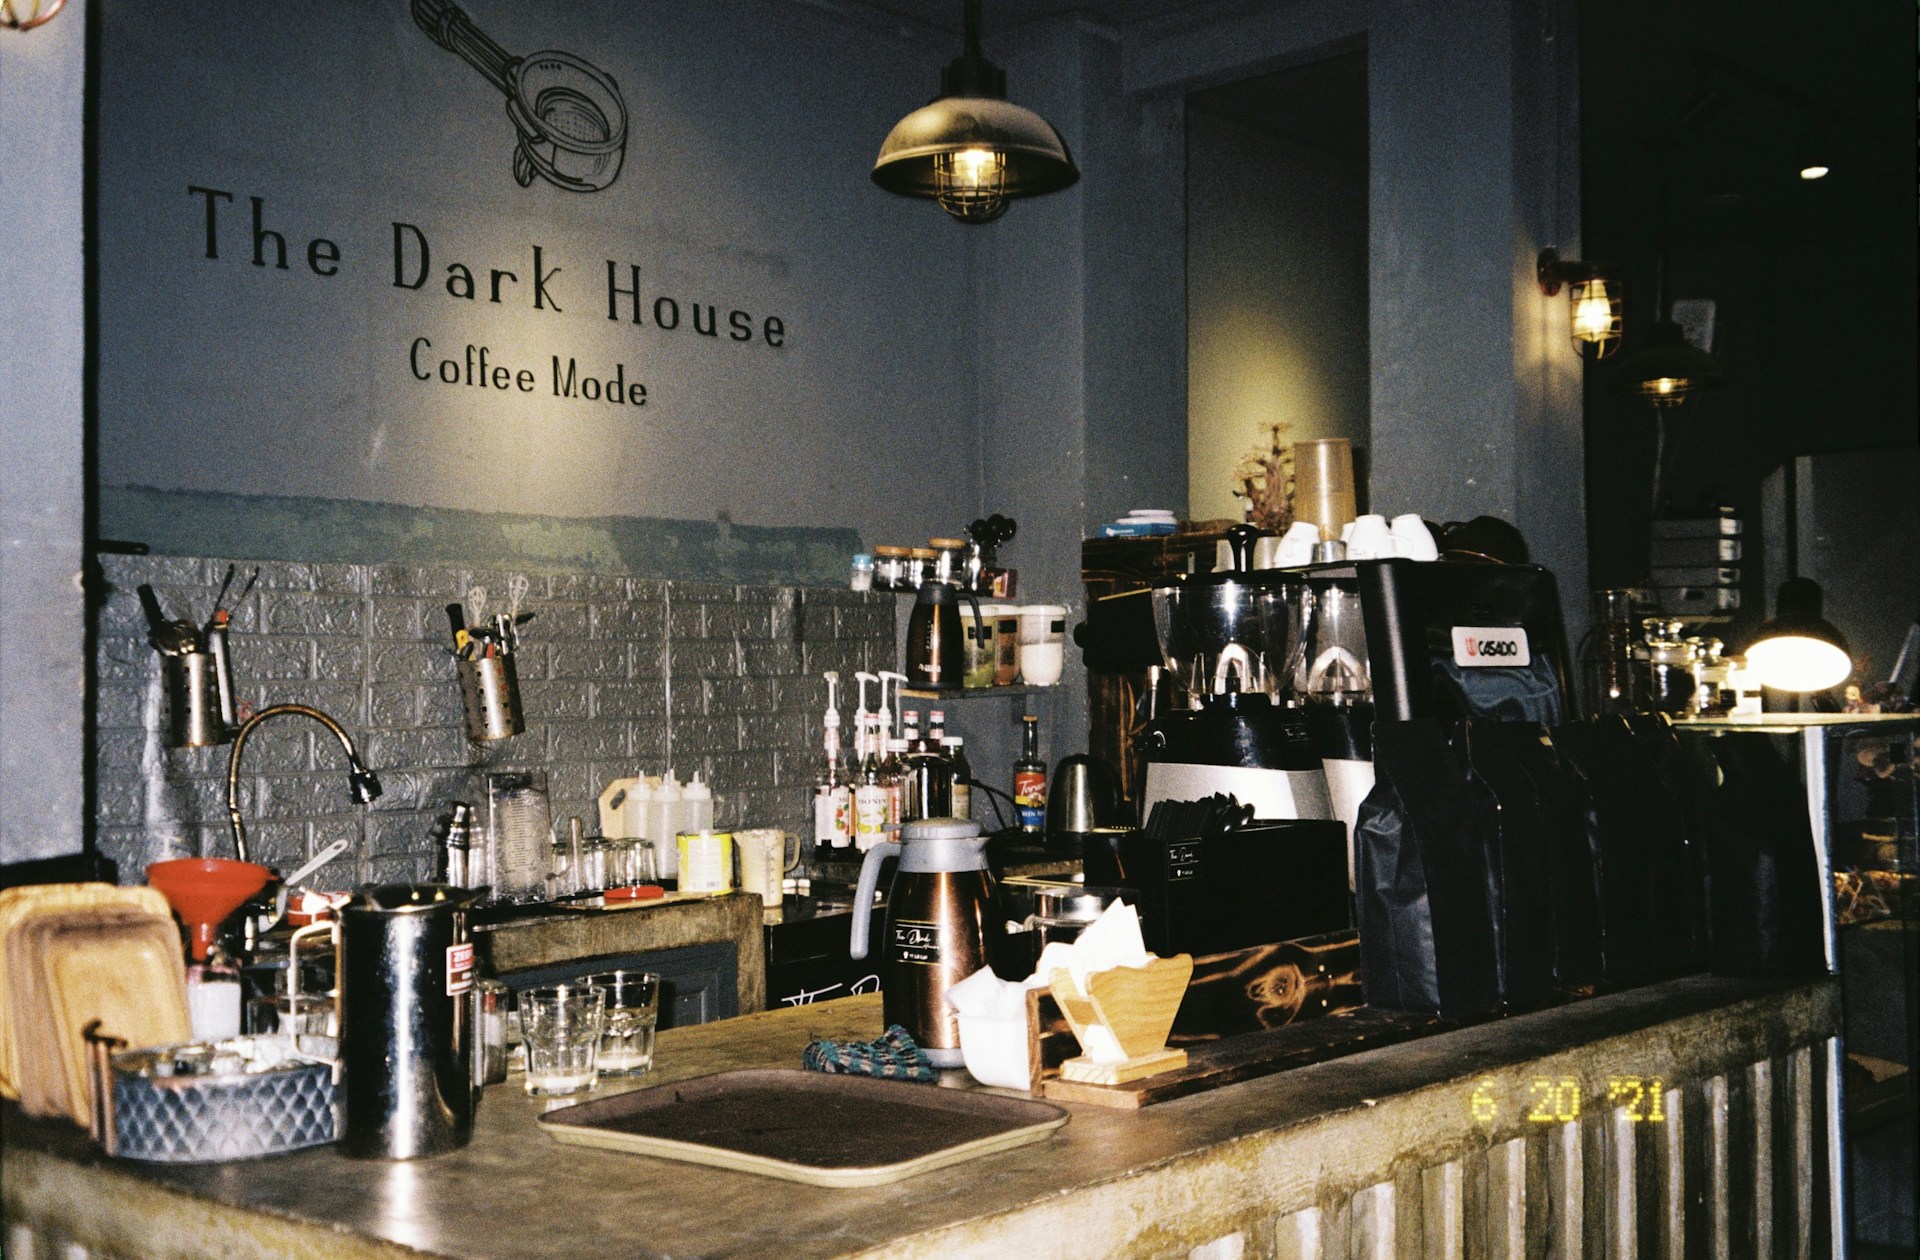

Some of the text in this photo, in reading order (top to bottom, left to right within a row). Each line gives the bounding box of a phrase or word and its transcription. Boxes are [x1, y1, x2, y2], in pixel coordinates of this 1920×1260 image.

[188, 185, 786, 348] The Dark House
[409, 337, 649, 406] Coffee Mode
